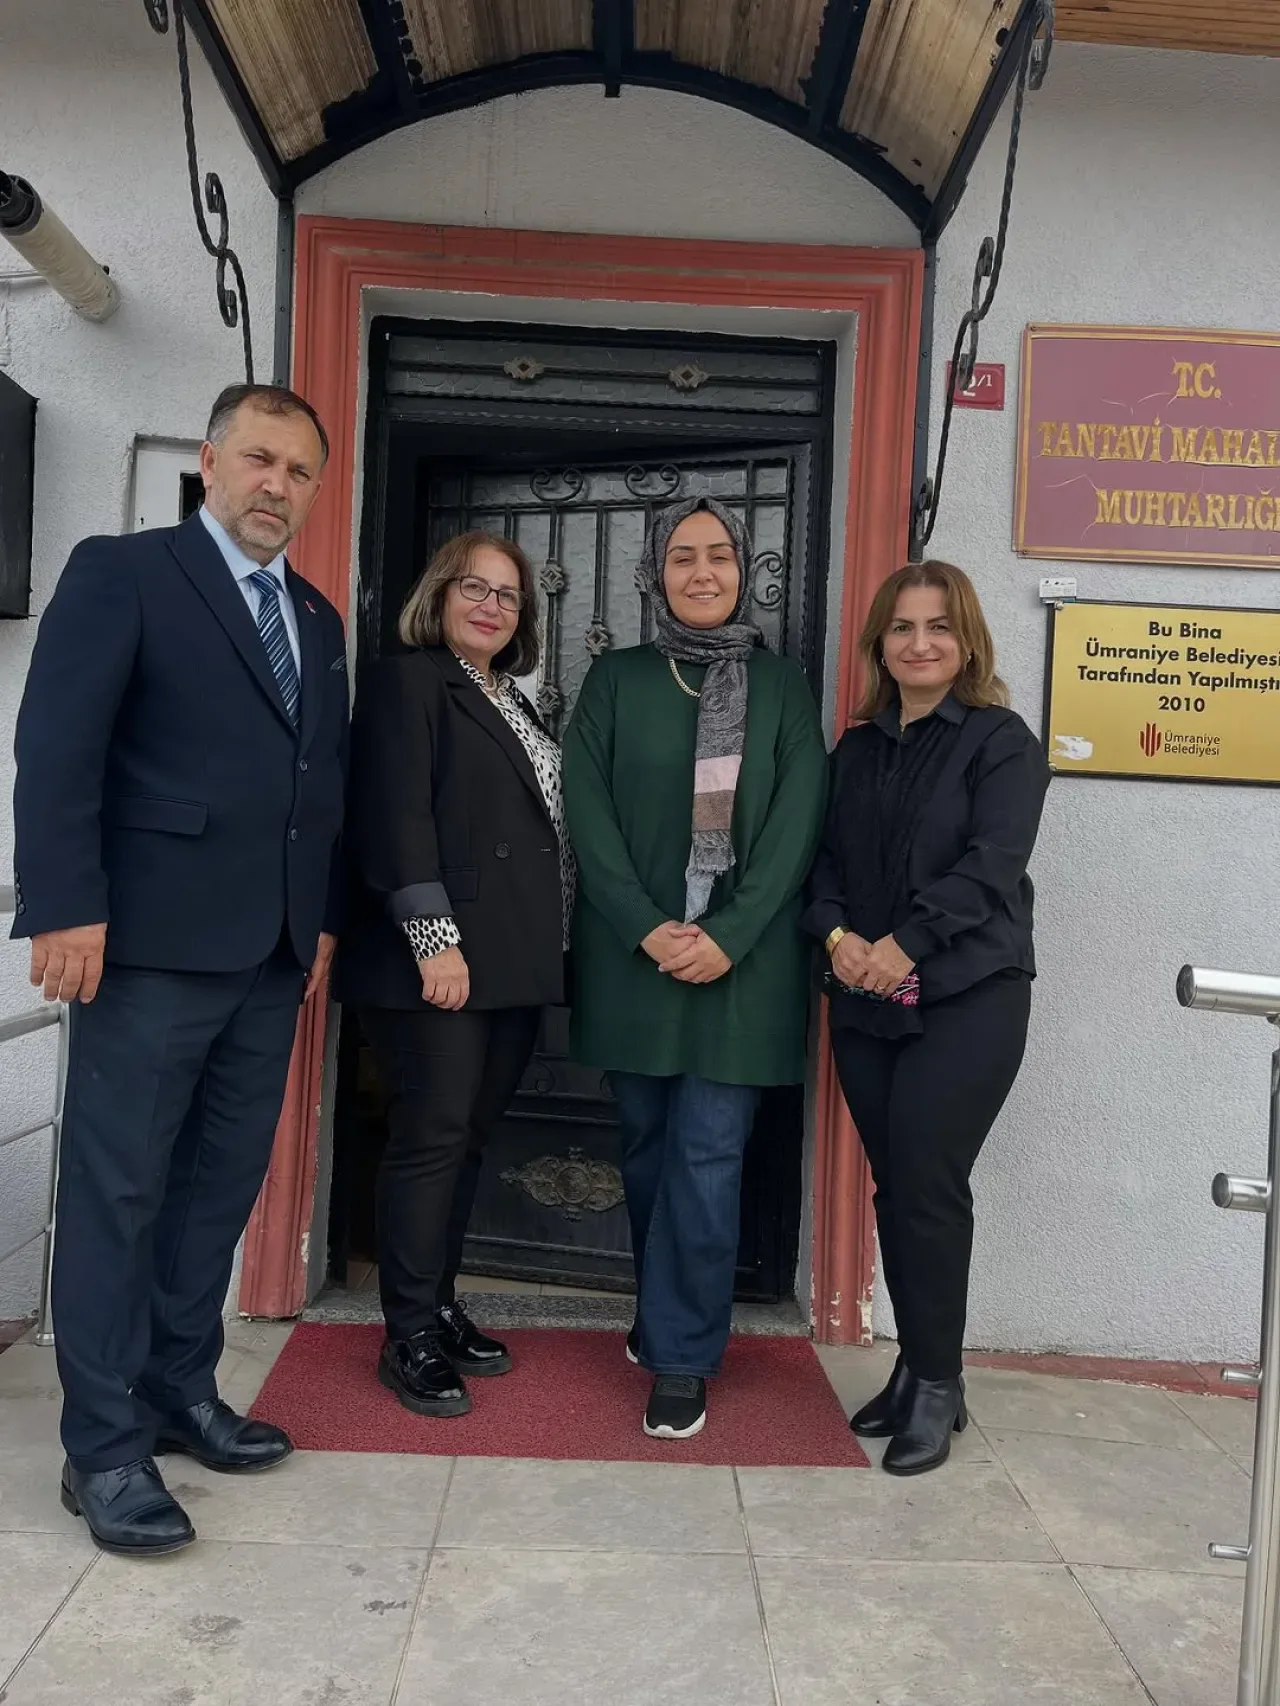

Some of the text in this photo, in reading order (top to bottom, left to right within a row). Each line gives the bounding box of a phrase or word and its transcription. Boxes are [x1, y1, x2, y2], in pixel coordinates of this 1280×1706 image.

[1172, 361, 1222, 398] T.C.
[1038, 415, 1163, 461] TANTAVİ
[1149, 622, 1222, 640] Bu Bina
[1086, 637, 1180, 665] Ümraniye
[1077, 665, 1181, 686] Tarafından
[1158, 696, 1206, 713] 2010
[1164, 730, 1221, 746] Ümraniye
[1164, 743, 1220, 757] Belediyesi
